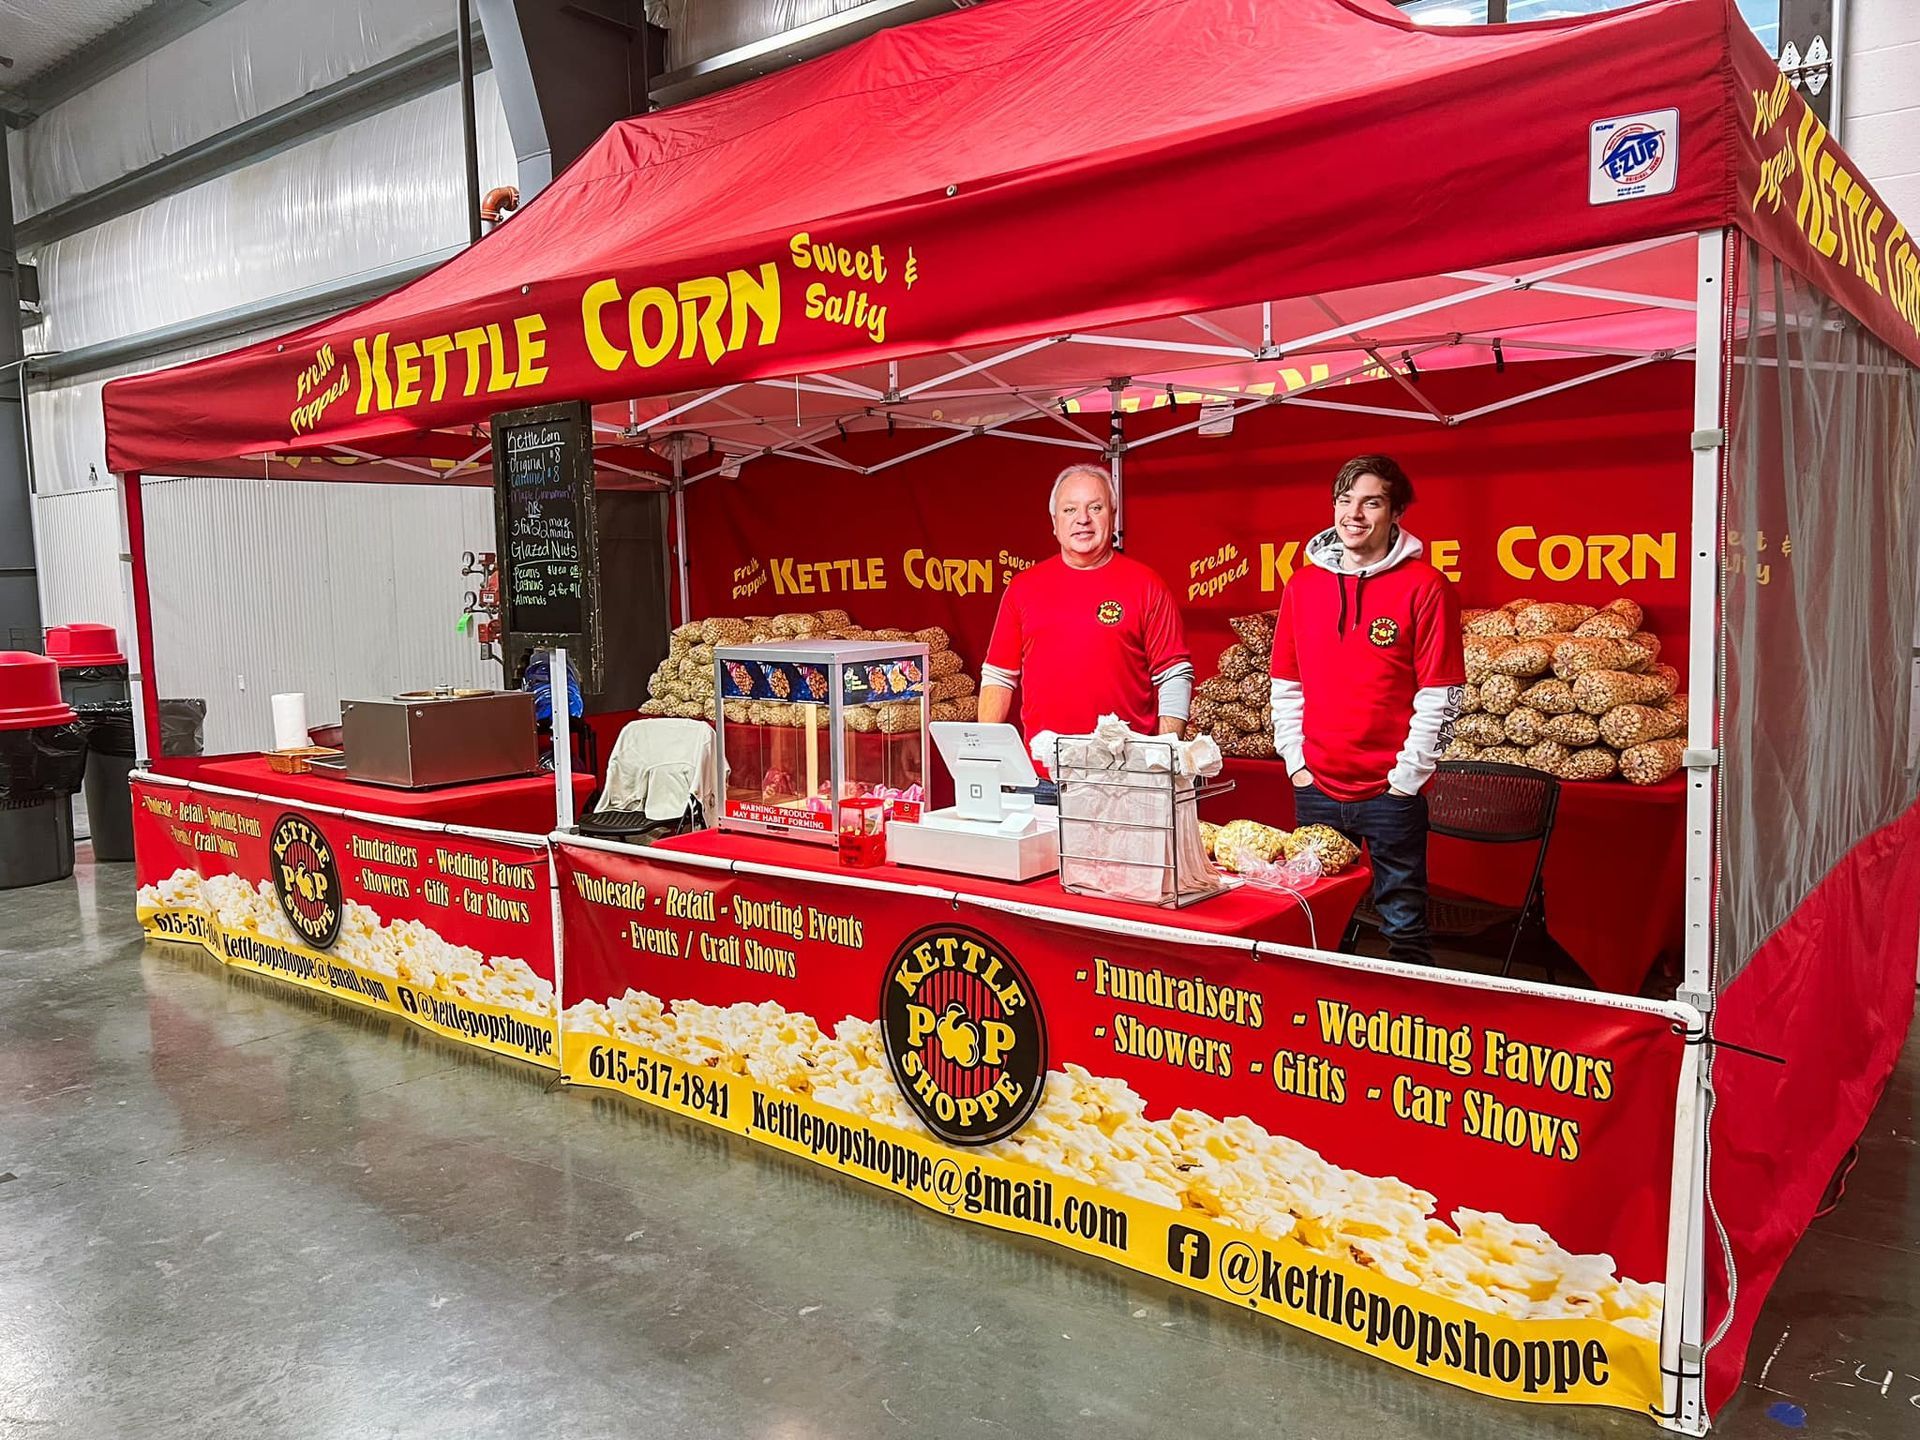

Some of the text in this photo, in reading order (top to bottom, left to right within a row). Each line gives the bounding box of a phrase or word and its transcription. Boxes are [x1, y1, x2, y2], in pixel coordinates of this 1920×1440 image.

[1796, 99, 1883, 296] KETTLE
[790, 231, 918, 290] Sweet &
[353, 262, 781, 415] KETTLE CORN
[804, 282, 888, 343] Salty
[290, 365, 351, 436] Popped
[296, 342, 335, 402] Fresh
[507, 427, 560, 455] Kettle Corn
[510, 452, 546, 477] Original
[511, 519, 521, 536] 3
[520, 517, 531, 535] for
[511, 539, 578, 560] Glazed Nuts
[1496, 525, 1677, 586] CORN
[548, 583, 558, 597] 2
[770, 548, 993, 597] KETTLE CORN
[1187, 558, 1250, 602] Popped
[1189, 542, 1239, 579] Fresh
[515, 594, 547, 606] Almonds
[179, 801, 205, 824] Retail
[732, 810, 825, 830] MAY BE HABIT FORMING
[779, 808, 816, 820] PRODUCT
[273, 821, 330, 869] KETTLE
[352, 834, 537, 891] Fundraisers Wedding Favors
[284, 895, 336, 939] SHOPPE
[361, 868, 531, 925] Showers Gifts Car Shows
[573, 870, 864, 949] Wholesale Retail Sporting Events
[222, 932, 391, 1003] Kettlepopshoppe@gmail.com
[630, 920, 680, 958] Events
[700, 931, 741, 967] Craft
[745, 938, 797, 979] Shows
[895, 937, 1027, 1017] KETTLE
[417, 991, 553, 1056] @kettlepopshoppe
[1094, 957, 1264, 1029] Fundraisers
[1316, 998, 1473, 1076] Wedding
[1483, 1028, 1614, 1101] Favors
[588, 1045, 730, 1119] 615-517-1841
[901, 1050, 1024, 1127] SHOPPE
[1113, 1013, 1581, 1161] Showers Gifts Car Shows
[751, 1090, 1130, 1252] Kettlepopshoppe@gmail.com
[1218, 1240, 1611, 1394] @kettlepopshoppe
